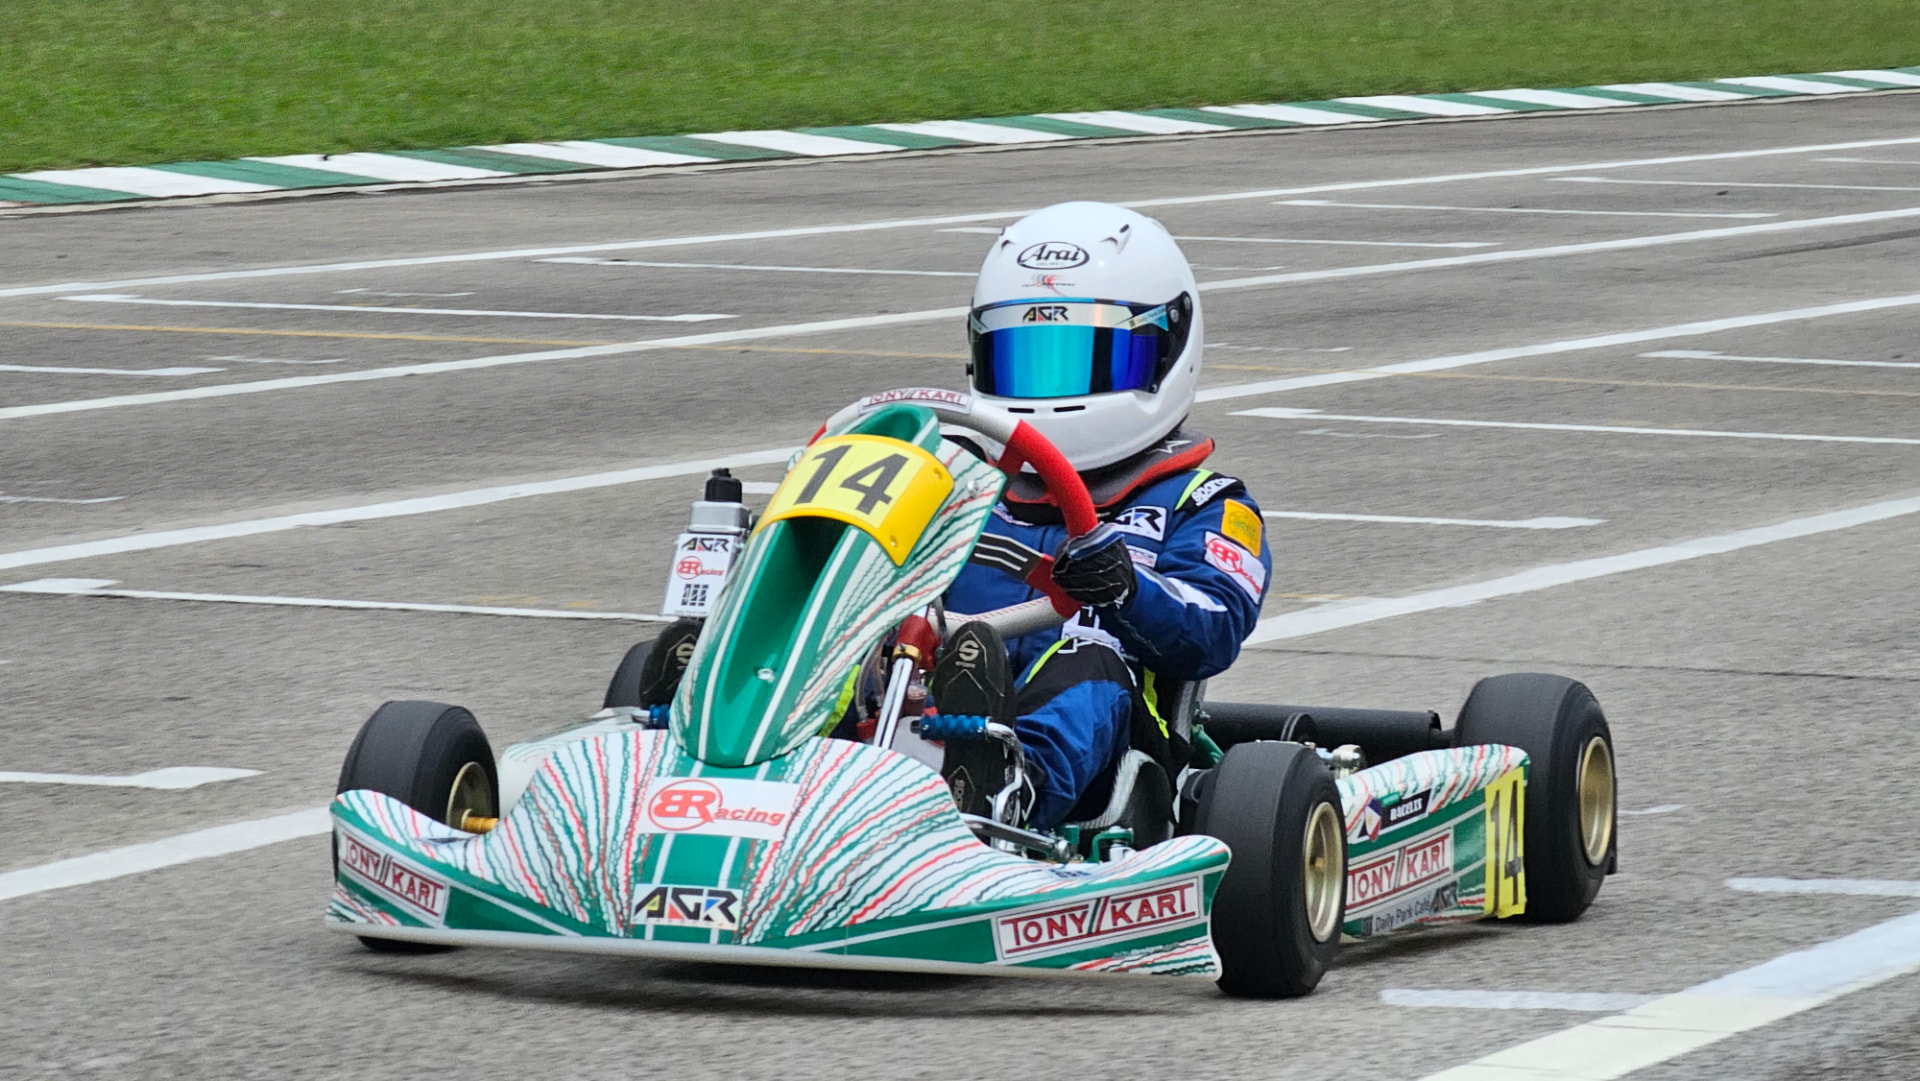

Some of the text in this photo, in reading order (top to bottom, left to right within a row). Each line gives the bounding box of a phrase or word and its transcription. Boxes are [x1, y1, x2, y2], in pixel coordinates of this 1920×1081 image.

[1020, 243, 1080, 262] Arai
[1022, 306, 1069, 322] AGR
[794, 445, 909, 515] 14
[681, 537, 730, 552] AGR
[345, 834, 382, 881] TONY
[390, 861, 444, 909] KART
[1347, 833, 1450, 903] TONY KART
[1490, 779, 1522, 913] 14
[634, 886, 738, 924] AGR
[1001, 883, 1194, 946] TONY KART
